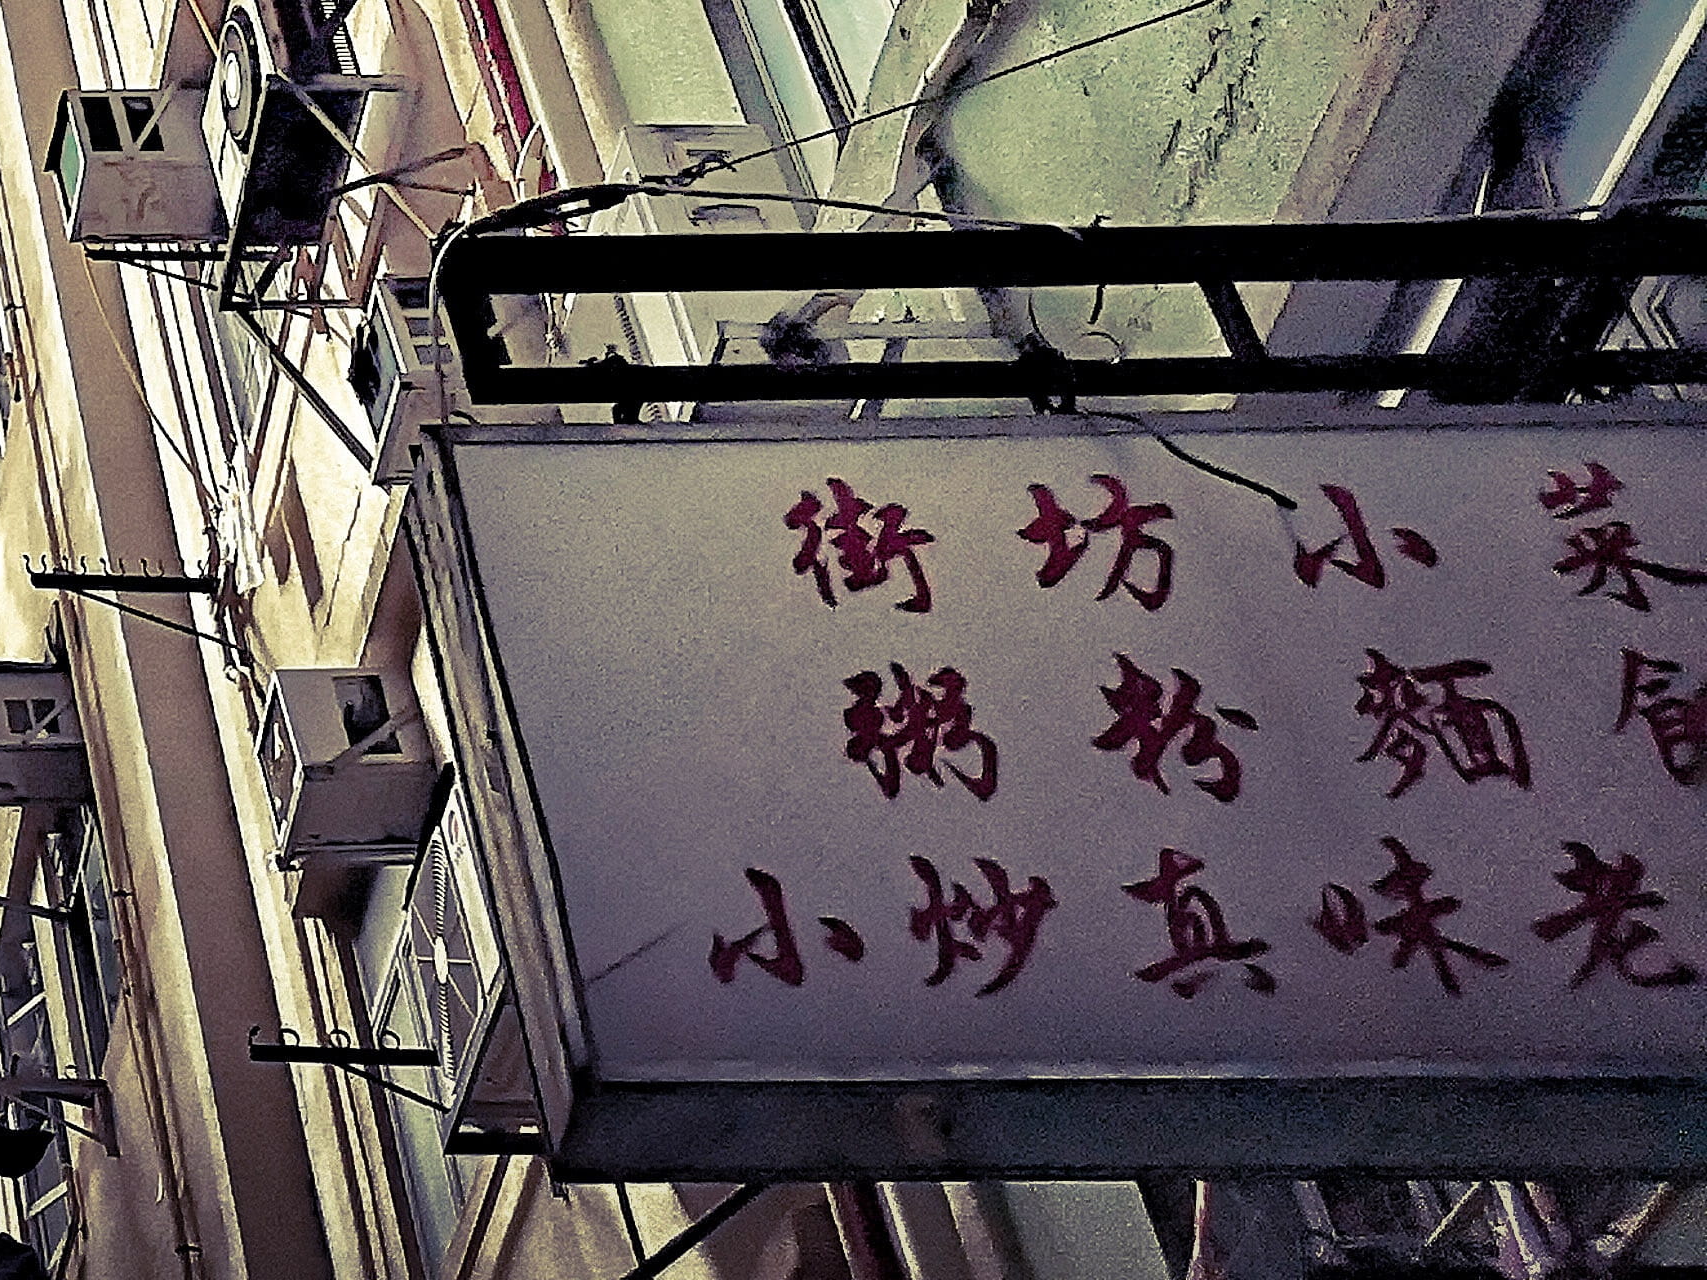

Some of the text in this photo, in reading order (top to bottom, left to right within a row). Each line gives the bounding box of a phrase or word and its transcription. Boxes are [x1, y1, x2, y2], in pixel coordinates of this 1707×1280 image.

[785, 461, 1707, 614] 街坊小菜
[707, 836, 1699, 1001] 小炒真味老
